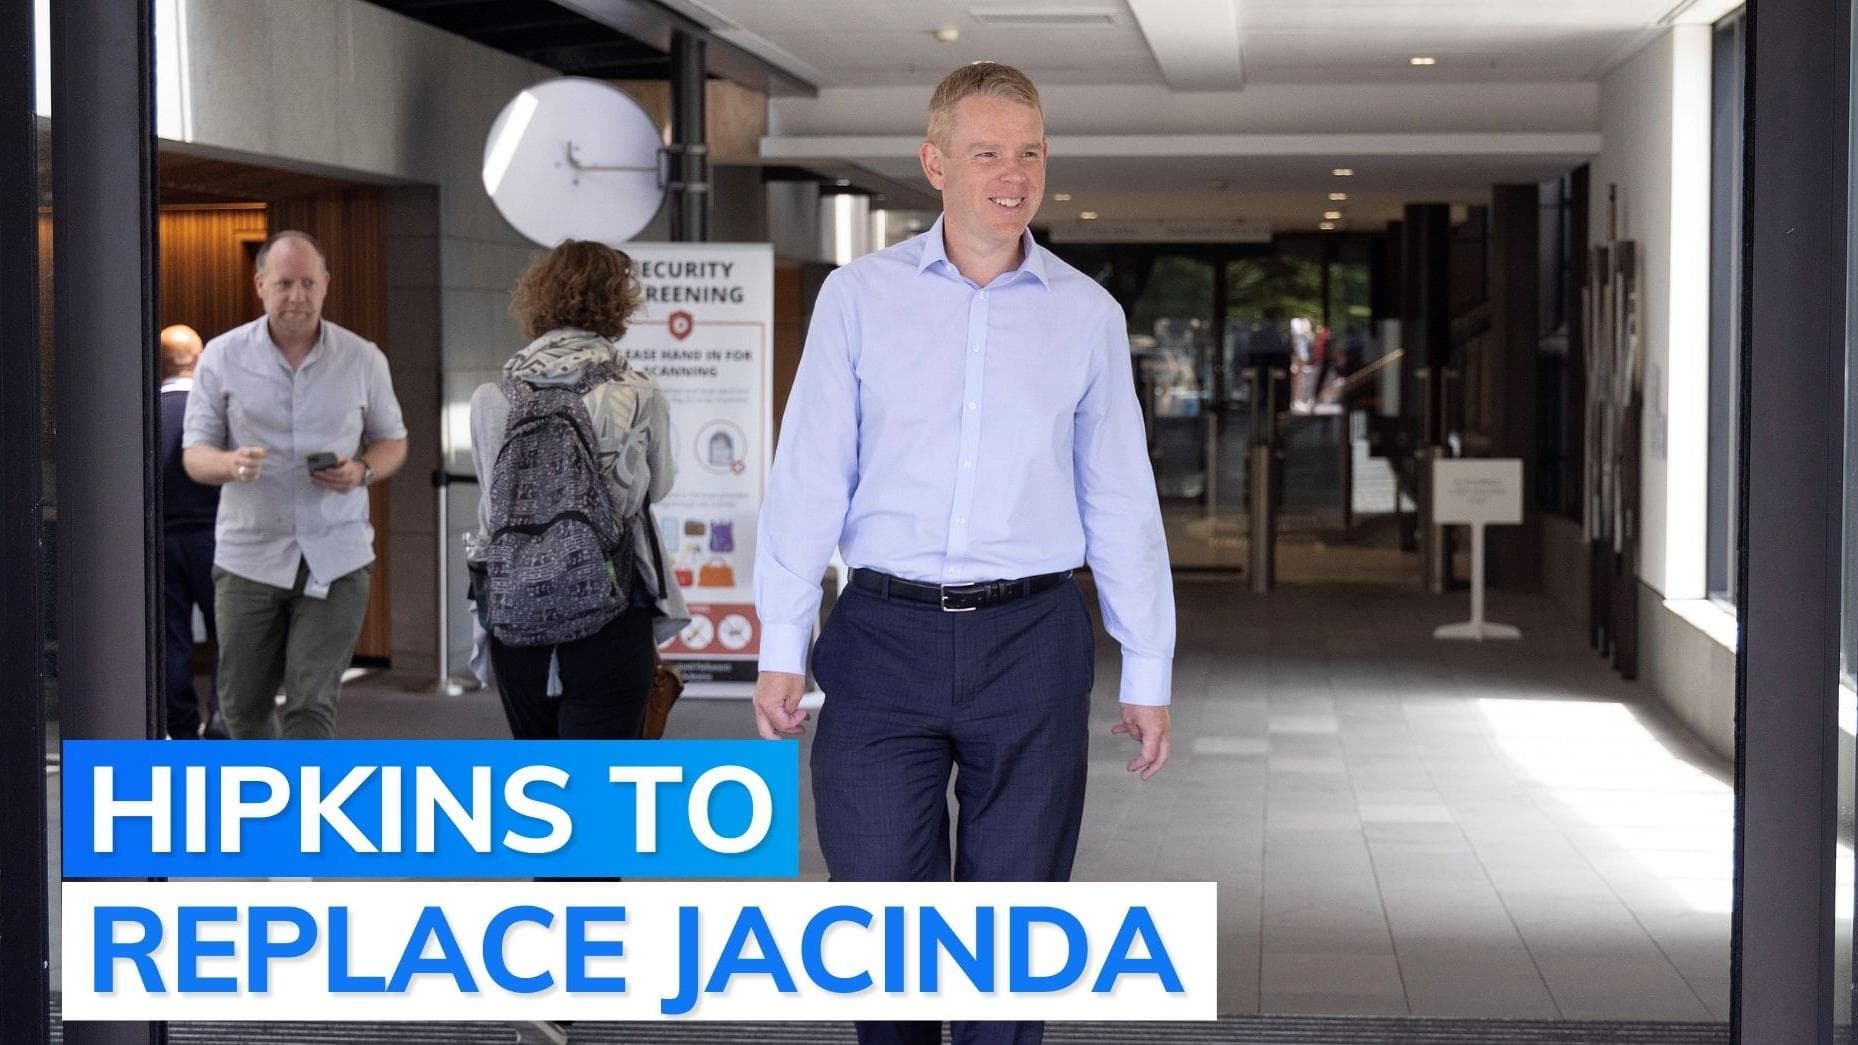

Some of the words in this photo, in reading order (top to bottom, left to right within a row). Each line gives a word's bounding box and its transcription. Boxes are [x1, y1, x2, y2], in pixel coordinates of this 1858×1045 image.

[641, 261, 733, 278] ECURITY
[646, 286, 744, 303] REENING
[661, 349, 702, 360] HAND
[706, 350, 721, 360] IN
[725, 349, 752, 360] FOR
